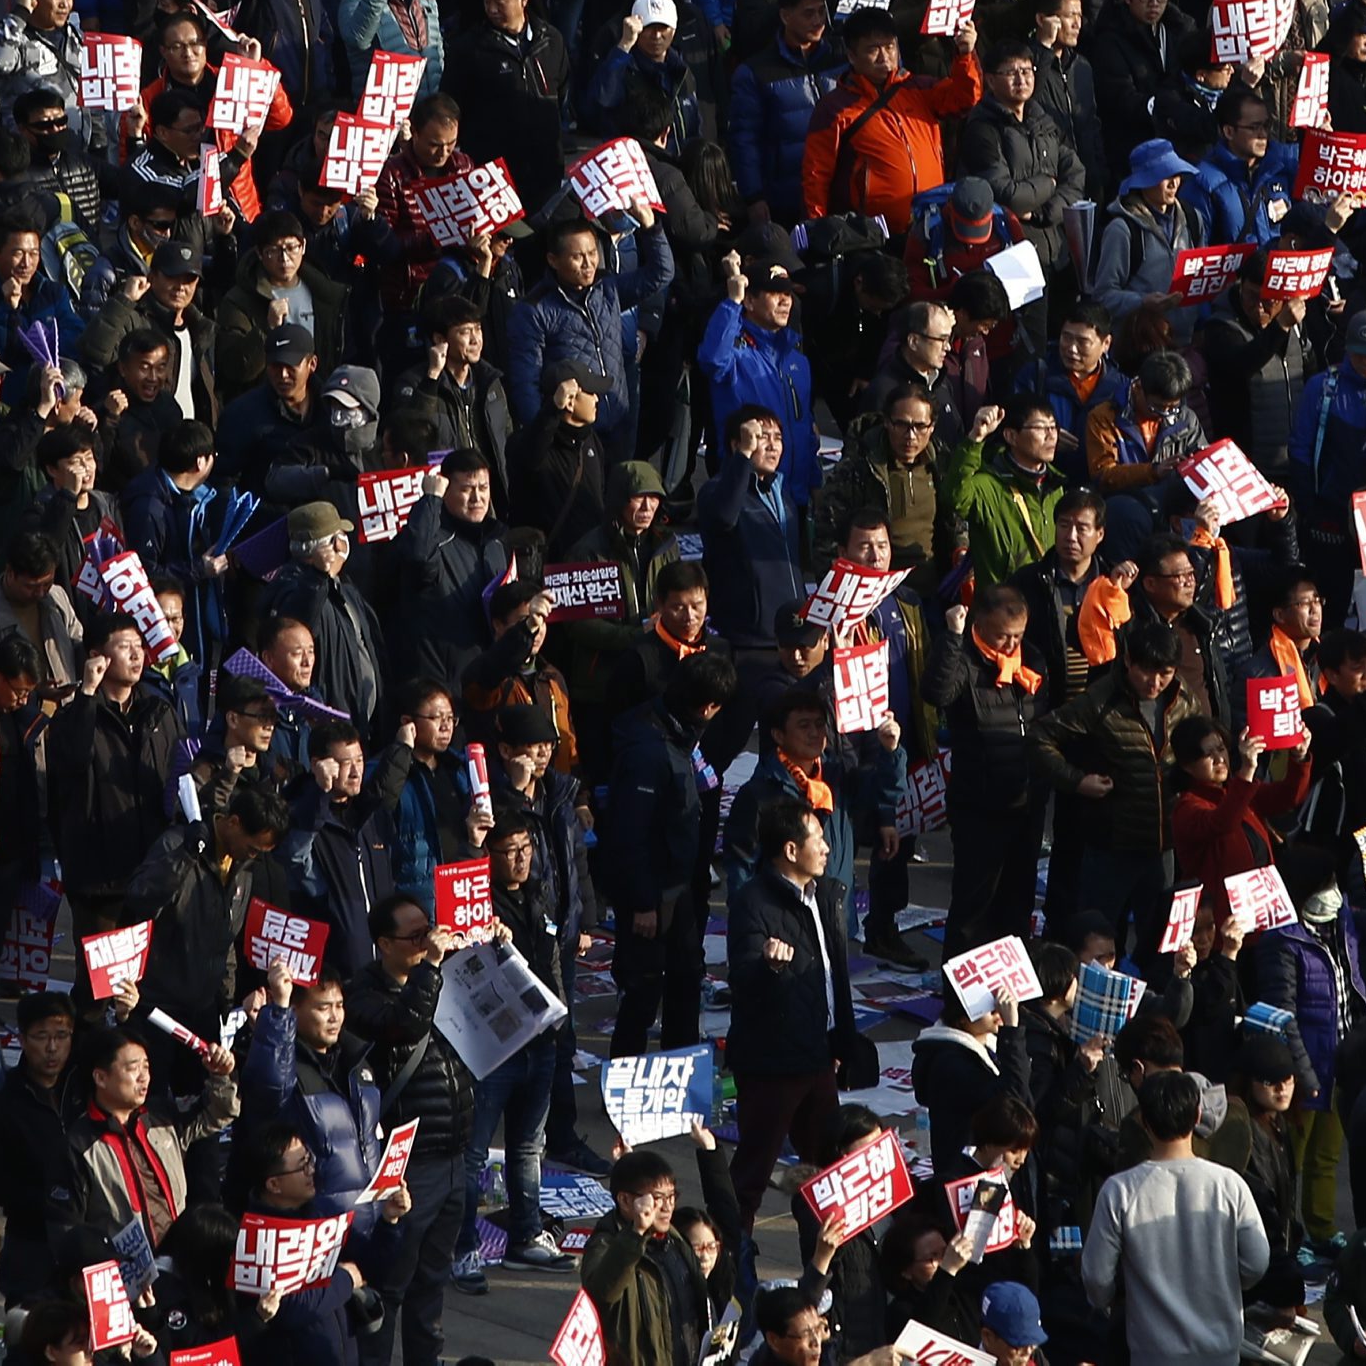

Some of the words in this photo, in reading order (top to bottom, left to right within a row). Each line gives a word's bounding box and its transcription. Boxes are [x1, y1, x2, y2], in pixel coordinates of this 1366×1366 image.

[571, 138, 650, 187] 내려와
[420, 160, 504, 220] 내려와
[1183, 253, 1240, 277] 박근혜
[1187, 275, 1227, 296] 퇴진
[84, 921, 148, 967] 재벌도
[606, 1056, 693, 1088] 끝내자
[605, 1085, 686, 1114] 노동개악
[811, 1139, 896, 1207] 박근혜
[842, 1177, 896, 1237] 퇴진
[236, 1213, 346, 1264] 내려와
